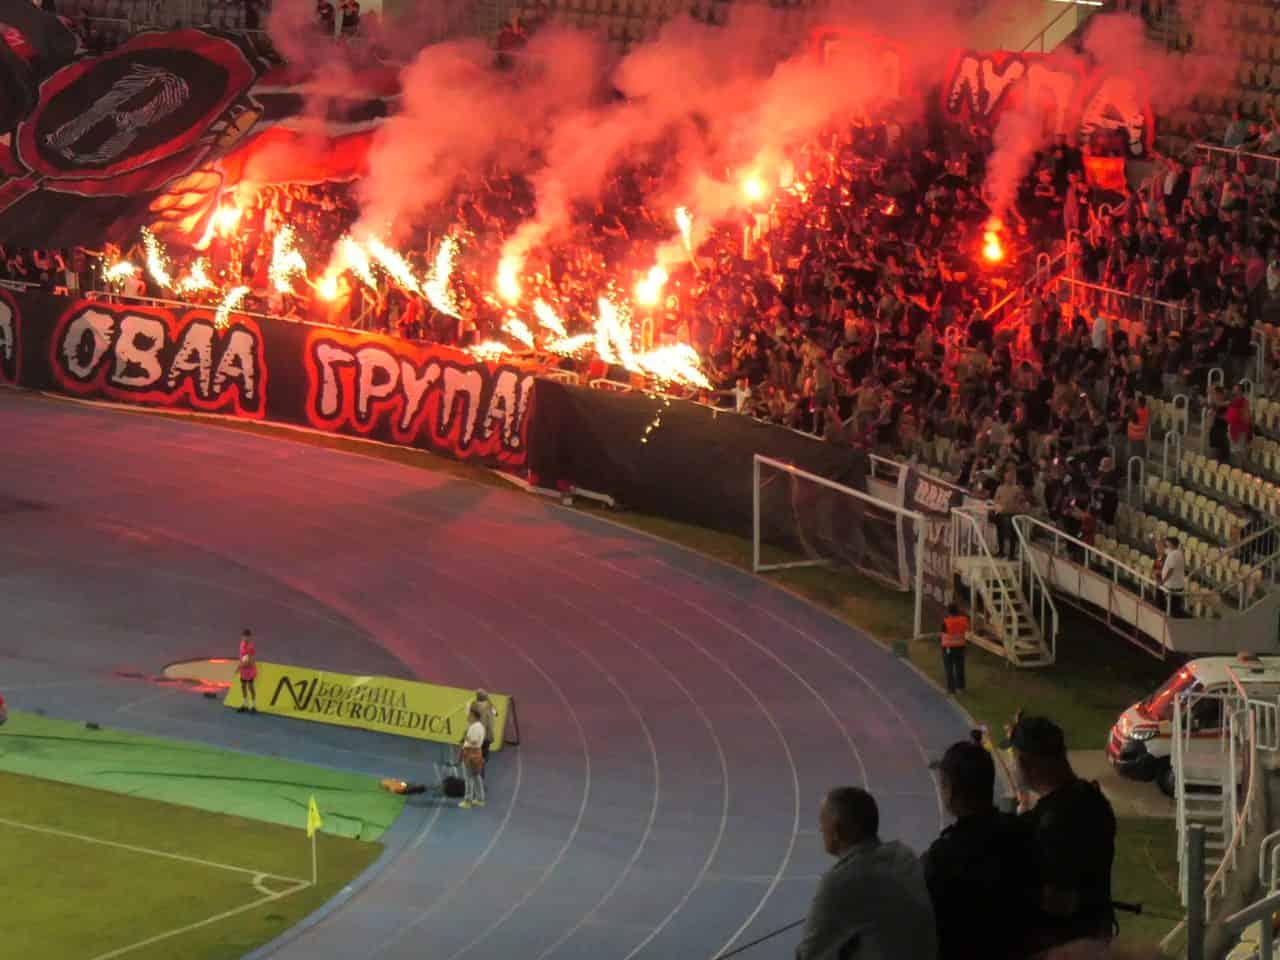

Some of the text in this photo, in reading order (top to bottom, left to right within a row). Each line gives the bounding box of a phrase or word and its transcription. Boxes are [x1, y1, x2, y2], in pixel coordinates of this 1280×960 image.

[63, 308, 256, 401] ОВАА
[312, 343, 535, 448] ГРУПА!
[308, 696, 453, 737] NEUROMEDICA
